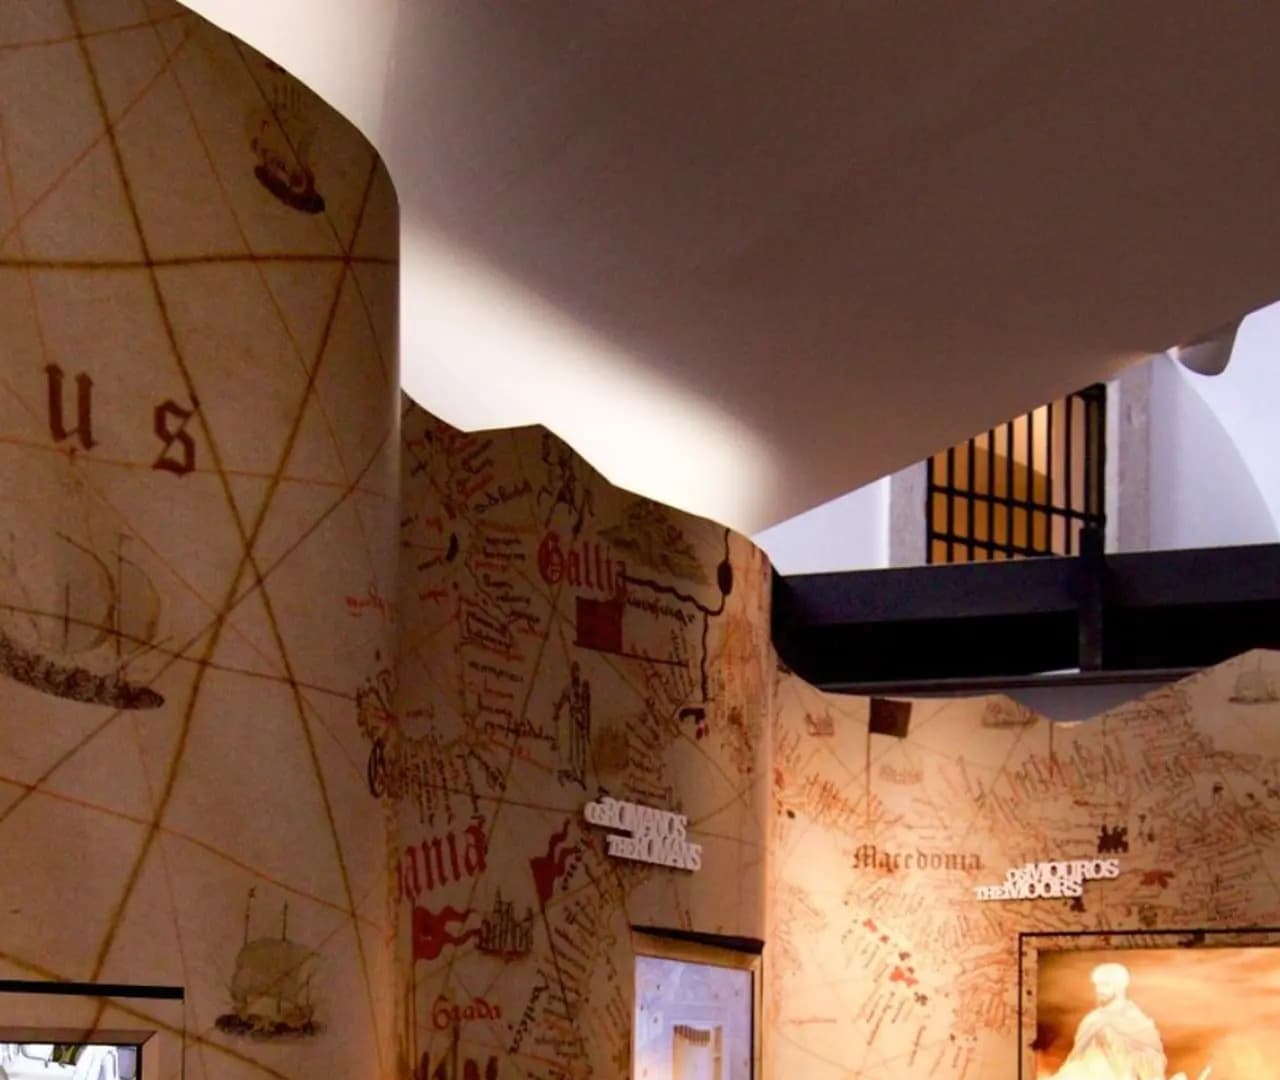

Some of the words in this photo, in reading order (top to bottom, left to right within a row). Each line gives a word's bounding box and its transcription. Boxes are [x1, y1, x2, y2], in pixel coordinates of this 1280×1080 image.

[633, 836, 703, 872] ROMANS
[852, 844, 984, 872] Macedonia
[1025, 858, 1120, 881] MOUROS
[1004, 879, 1083, 900] MOORS
